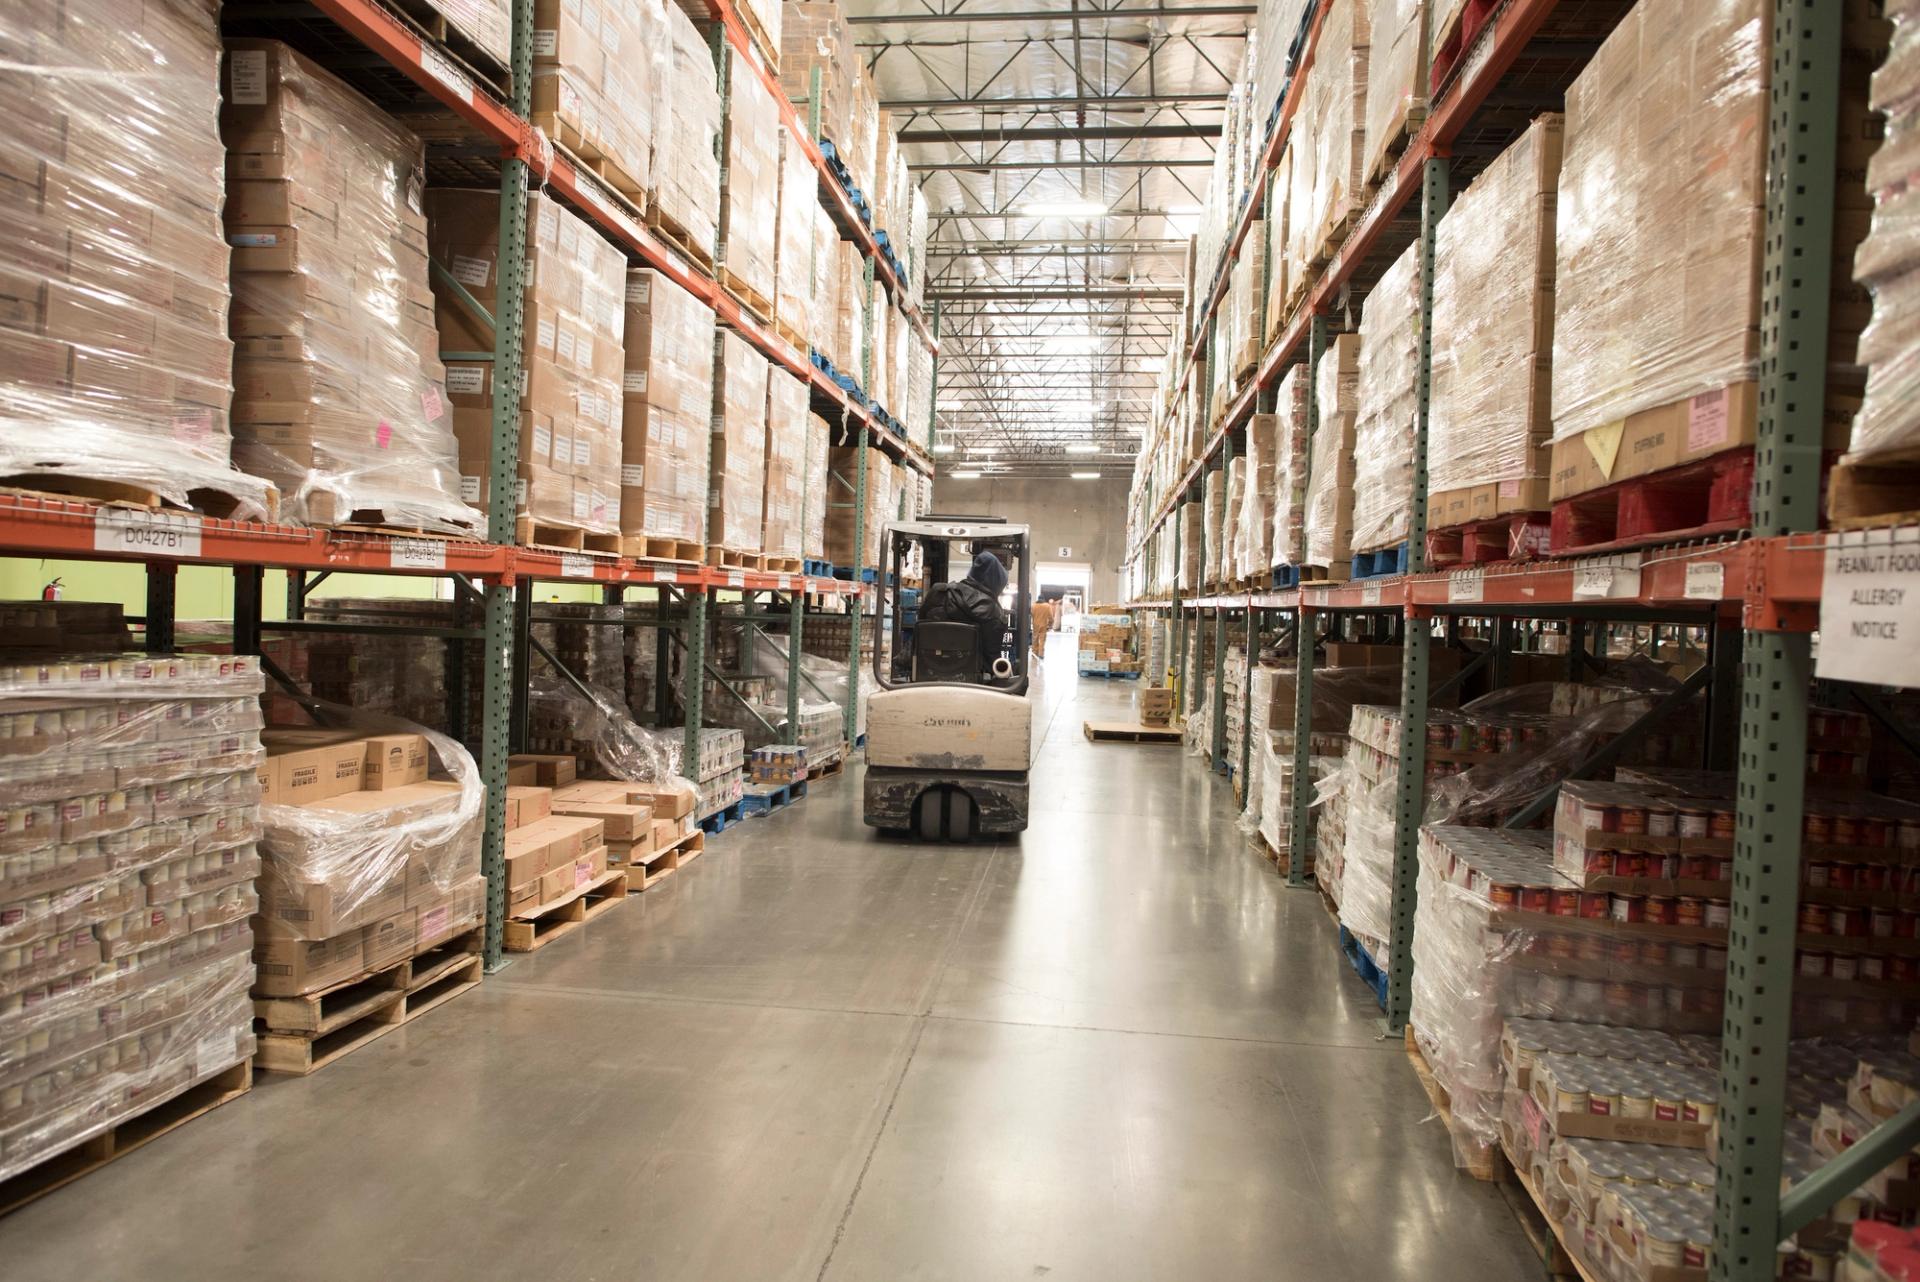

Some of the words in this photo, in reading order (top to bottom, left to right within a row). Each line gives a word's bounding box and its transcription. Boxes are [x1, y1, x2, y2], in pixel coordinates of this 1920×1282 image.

[125, 527, 183, 547] D0427B1
[1063, 548, 1068, 556] 5
[1836, 555, 1885, 574] PEANUT
[1887, 553, 1920, 572] FOO
[1849, 588, 1905, 606] ALLERGY
[1850, 621, 1898, 639] NOTICE
[294, 768, 316, 778] FRAGILE
[338, 760, 357, 769] FRAGILE
